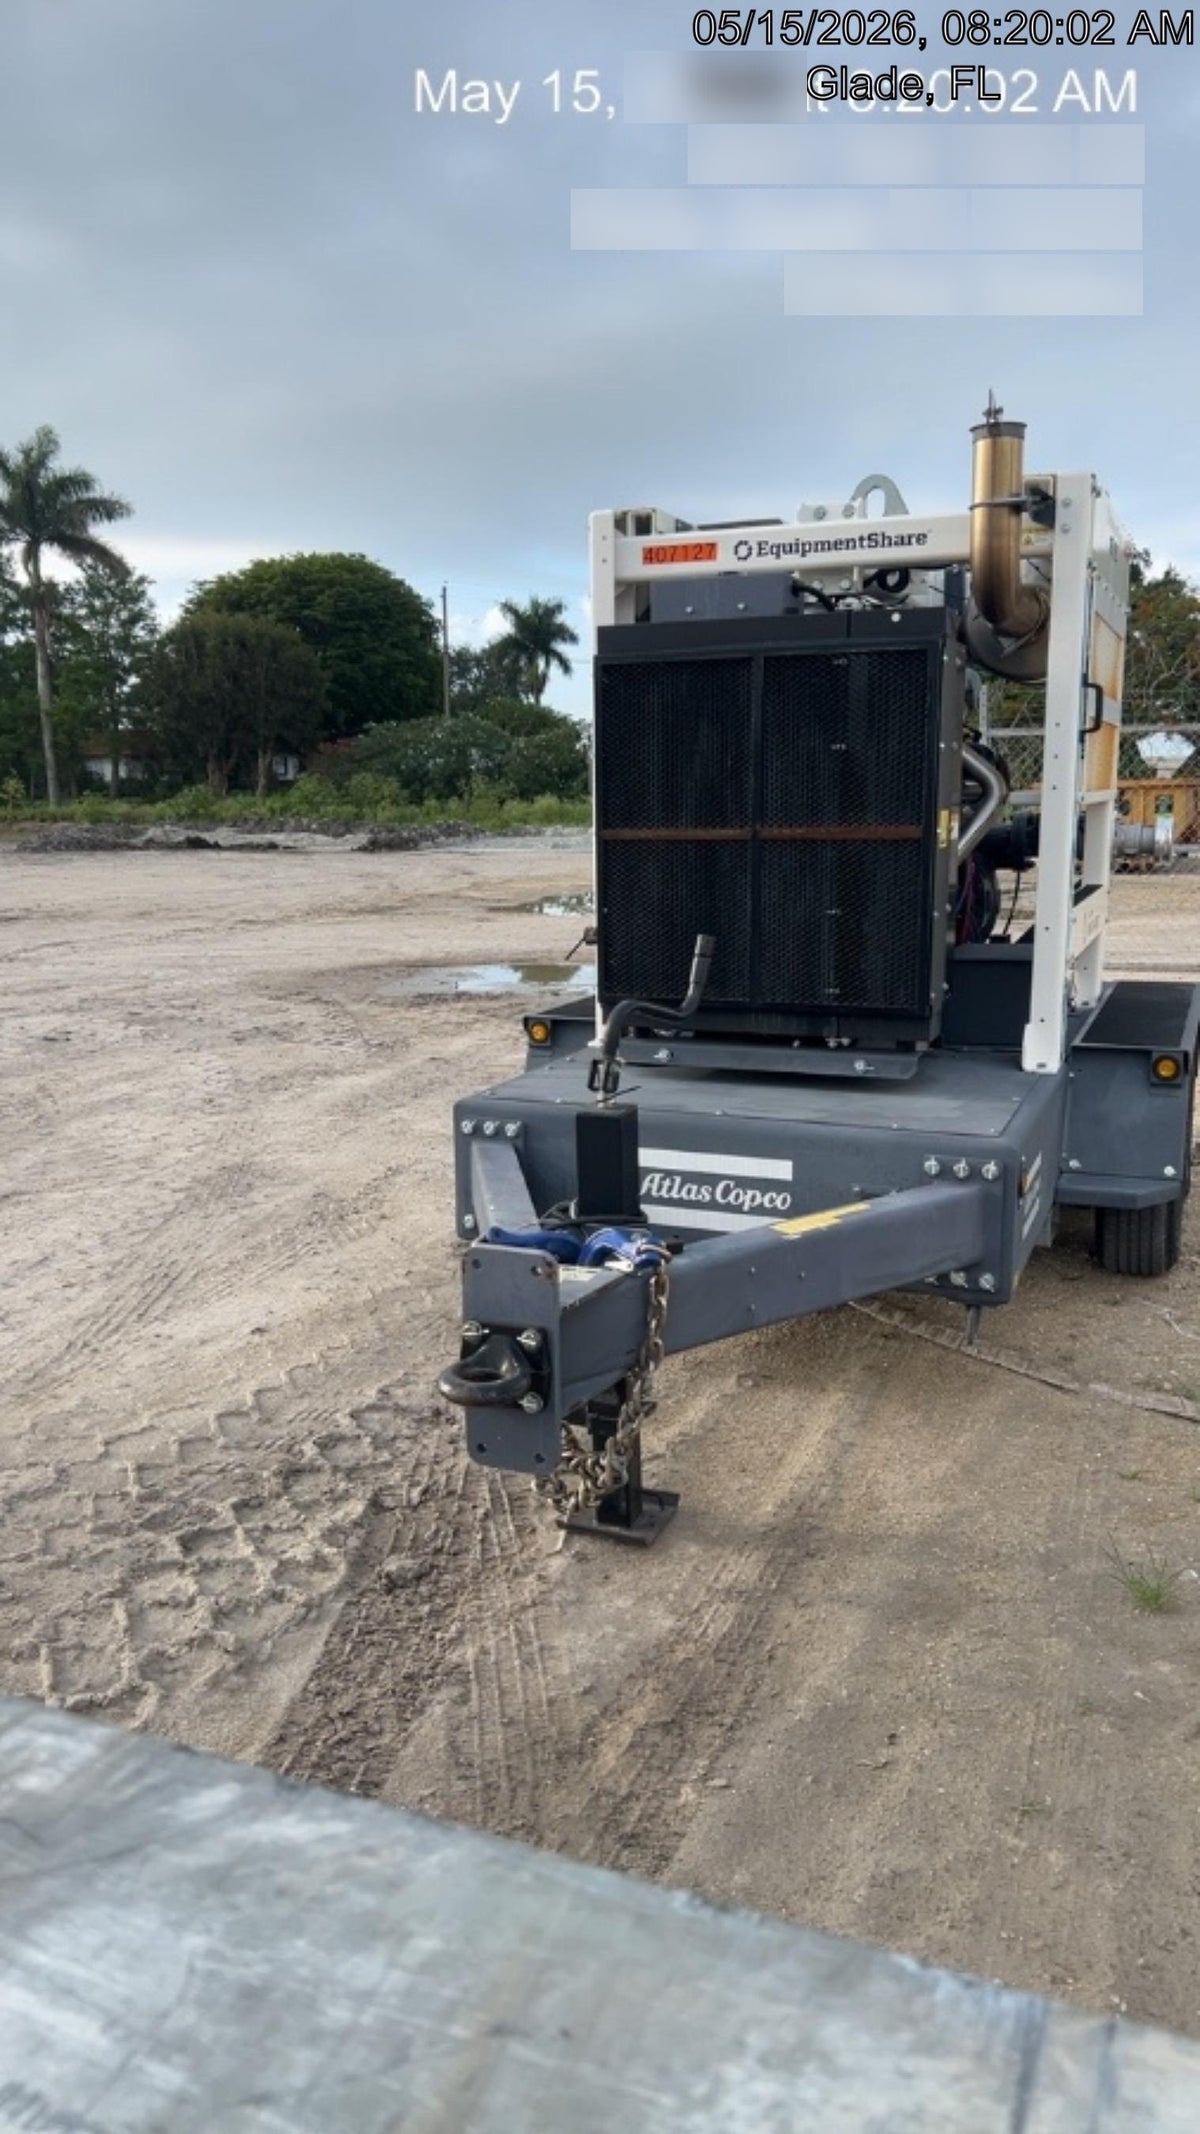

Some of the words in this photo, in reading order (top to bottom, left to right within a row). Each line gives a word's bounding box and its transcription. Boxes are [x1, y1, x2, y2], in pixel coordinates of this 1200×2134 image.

[643, 543, 717, 564] 407127
[756, 531, 928, 560] EquipmentShare
[639, 1173, 712, 1202] Atlas
[715, 1180, 792, 1212] Copco
